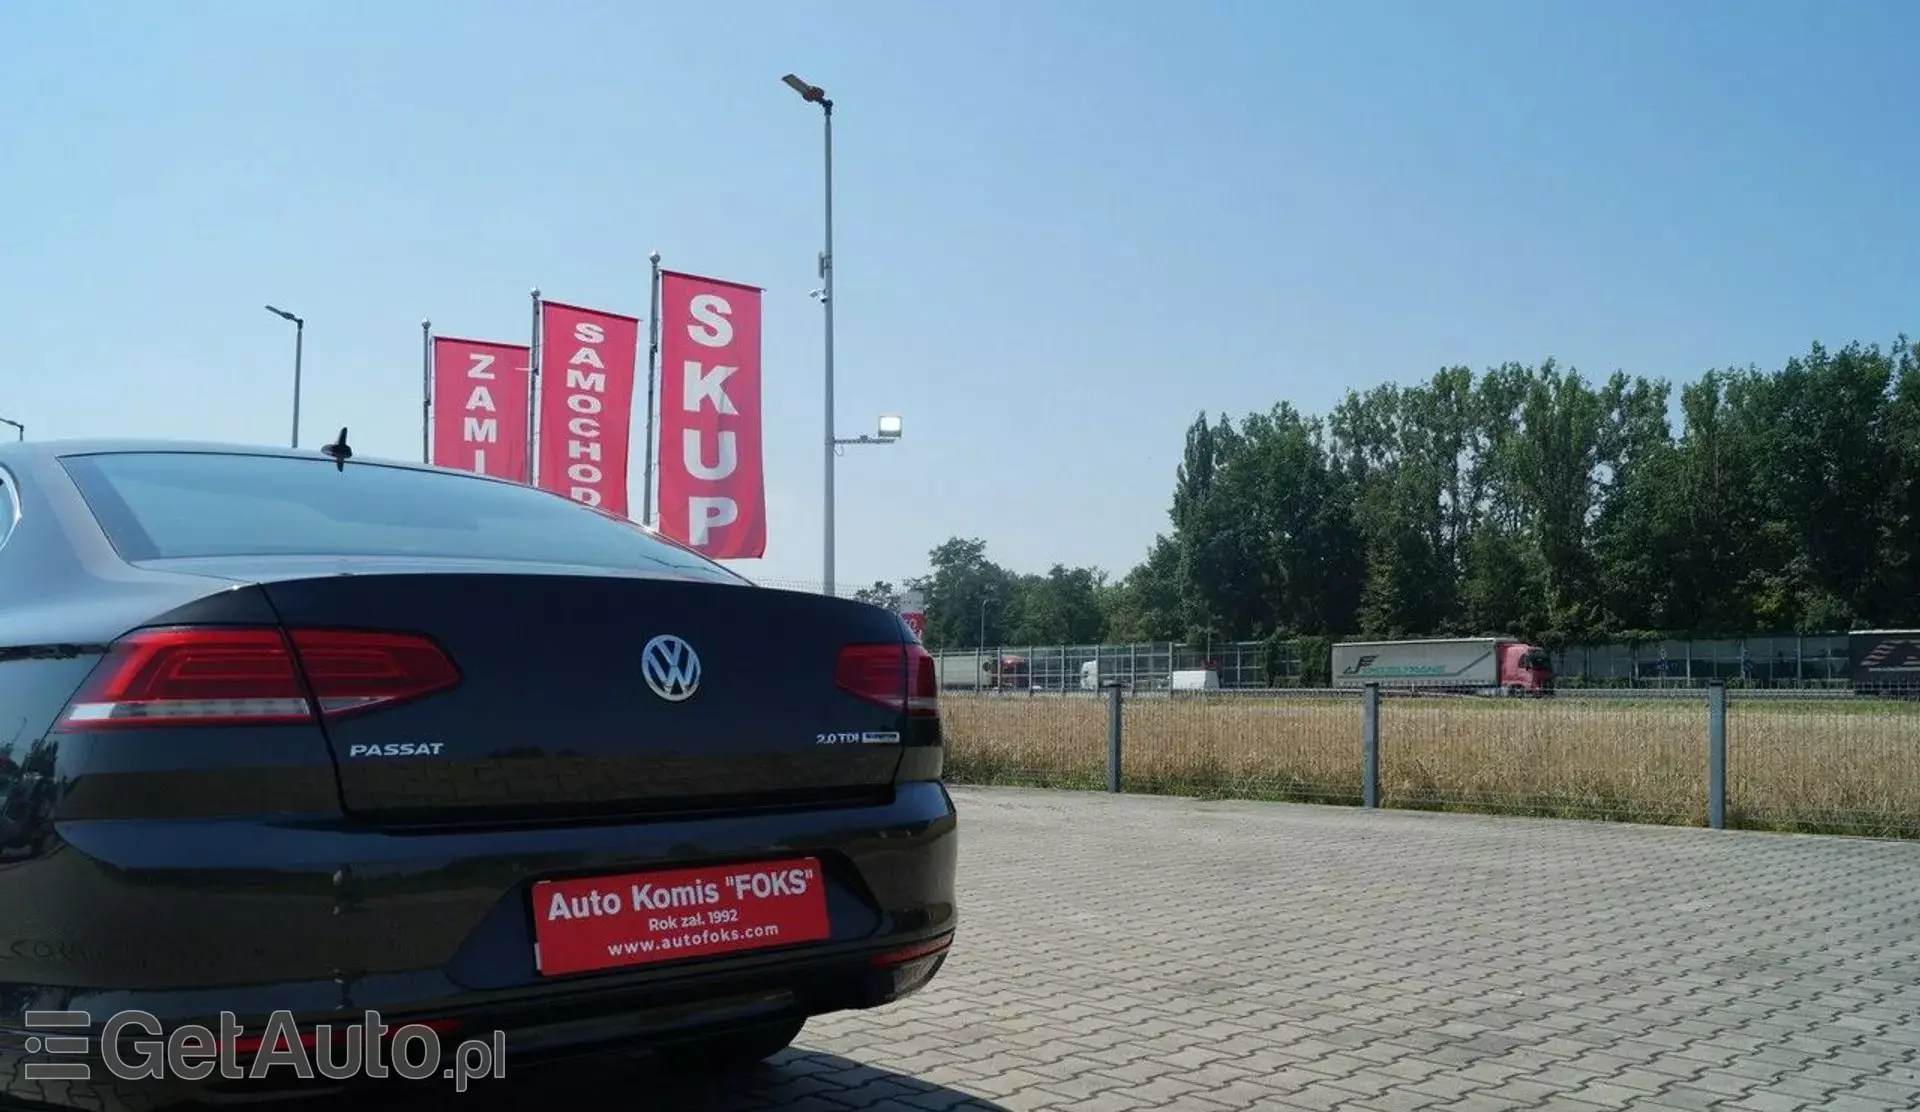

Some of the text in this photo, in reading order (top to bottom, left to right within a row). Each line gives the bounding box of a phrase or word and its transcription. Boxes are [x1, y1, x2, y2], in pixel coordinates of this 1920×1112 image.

[463, 353, 497, 475] ZAMI
[566, 322, 605, 507] SAMOCHOD
[682, 294, 738, 546] SKUP
[350, 742, 444, 757] PASSAT
[838, 732, 860, 744] TDI
[548, 867, 814, 921] Auto Komis "FOKS"
[608, 923, 779, 956] www.autofoks.com
[649, 916, 678, 932] Rok
[708, 909, 739, 924] 1992
